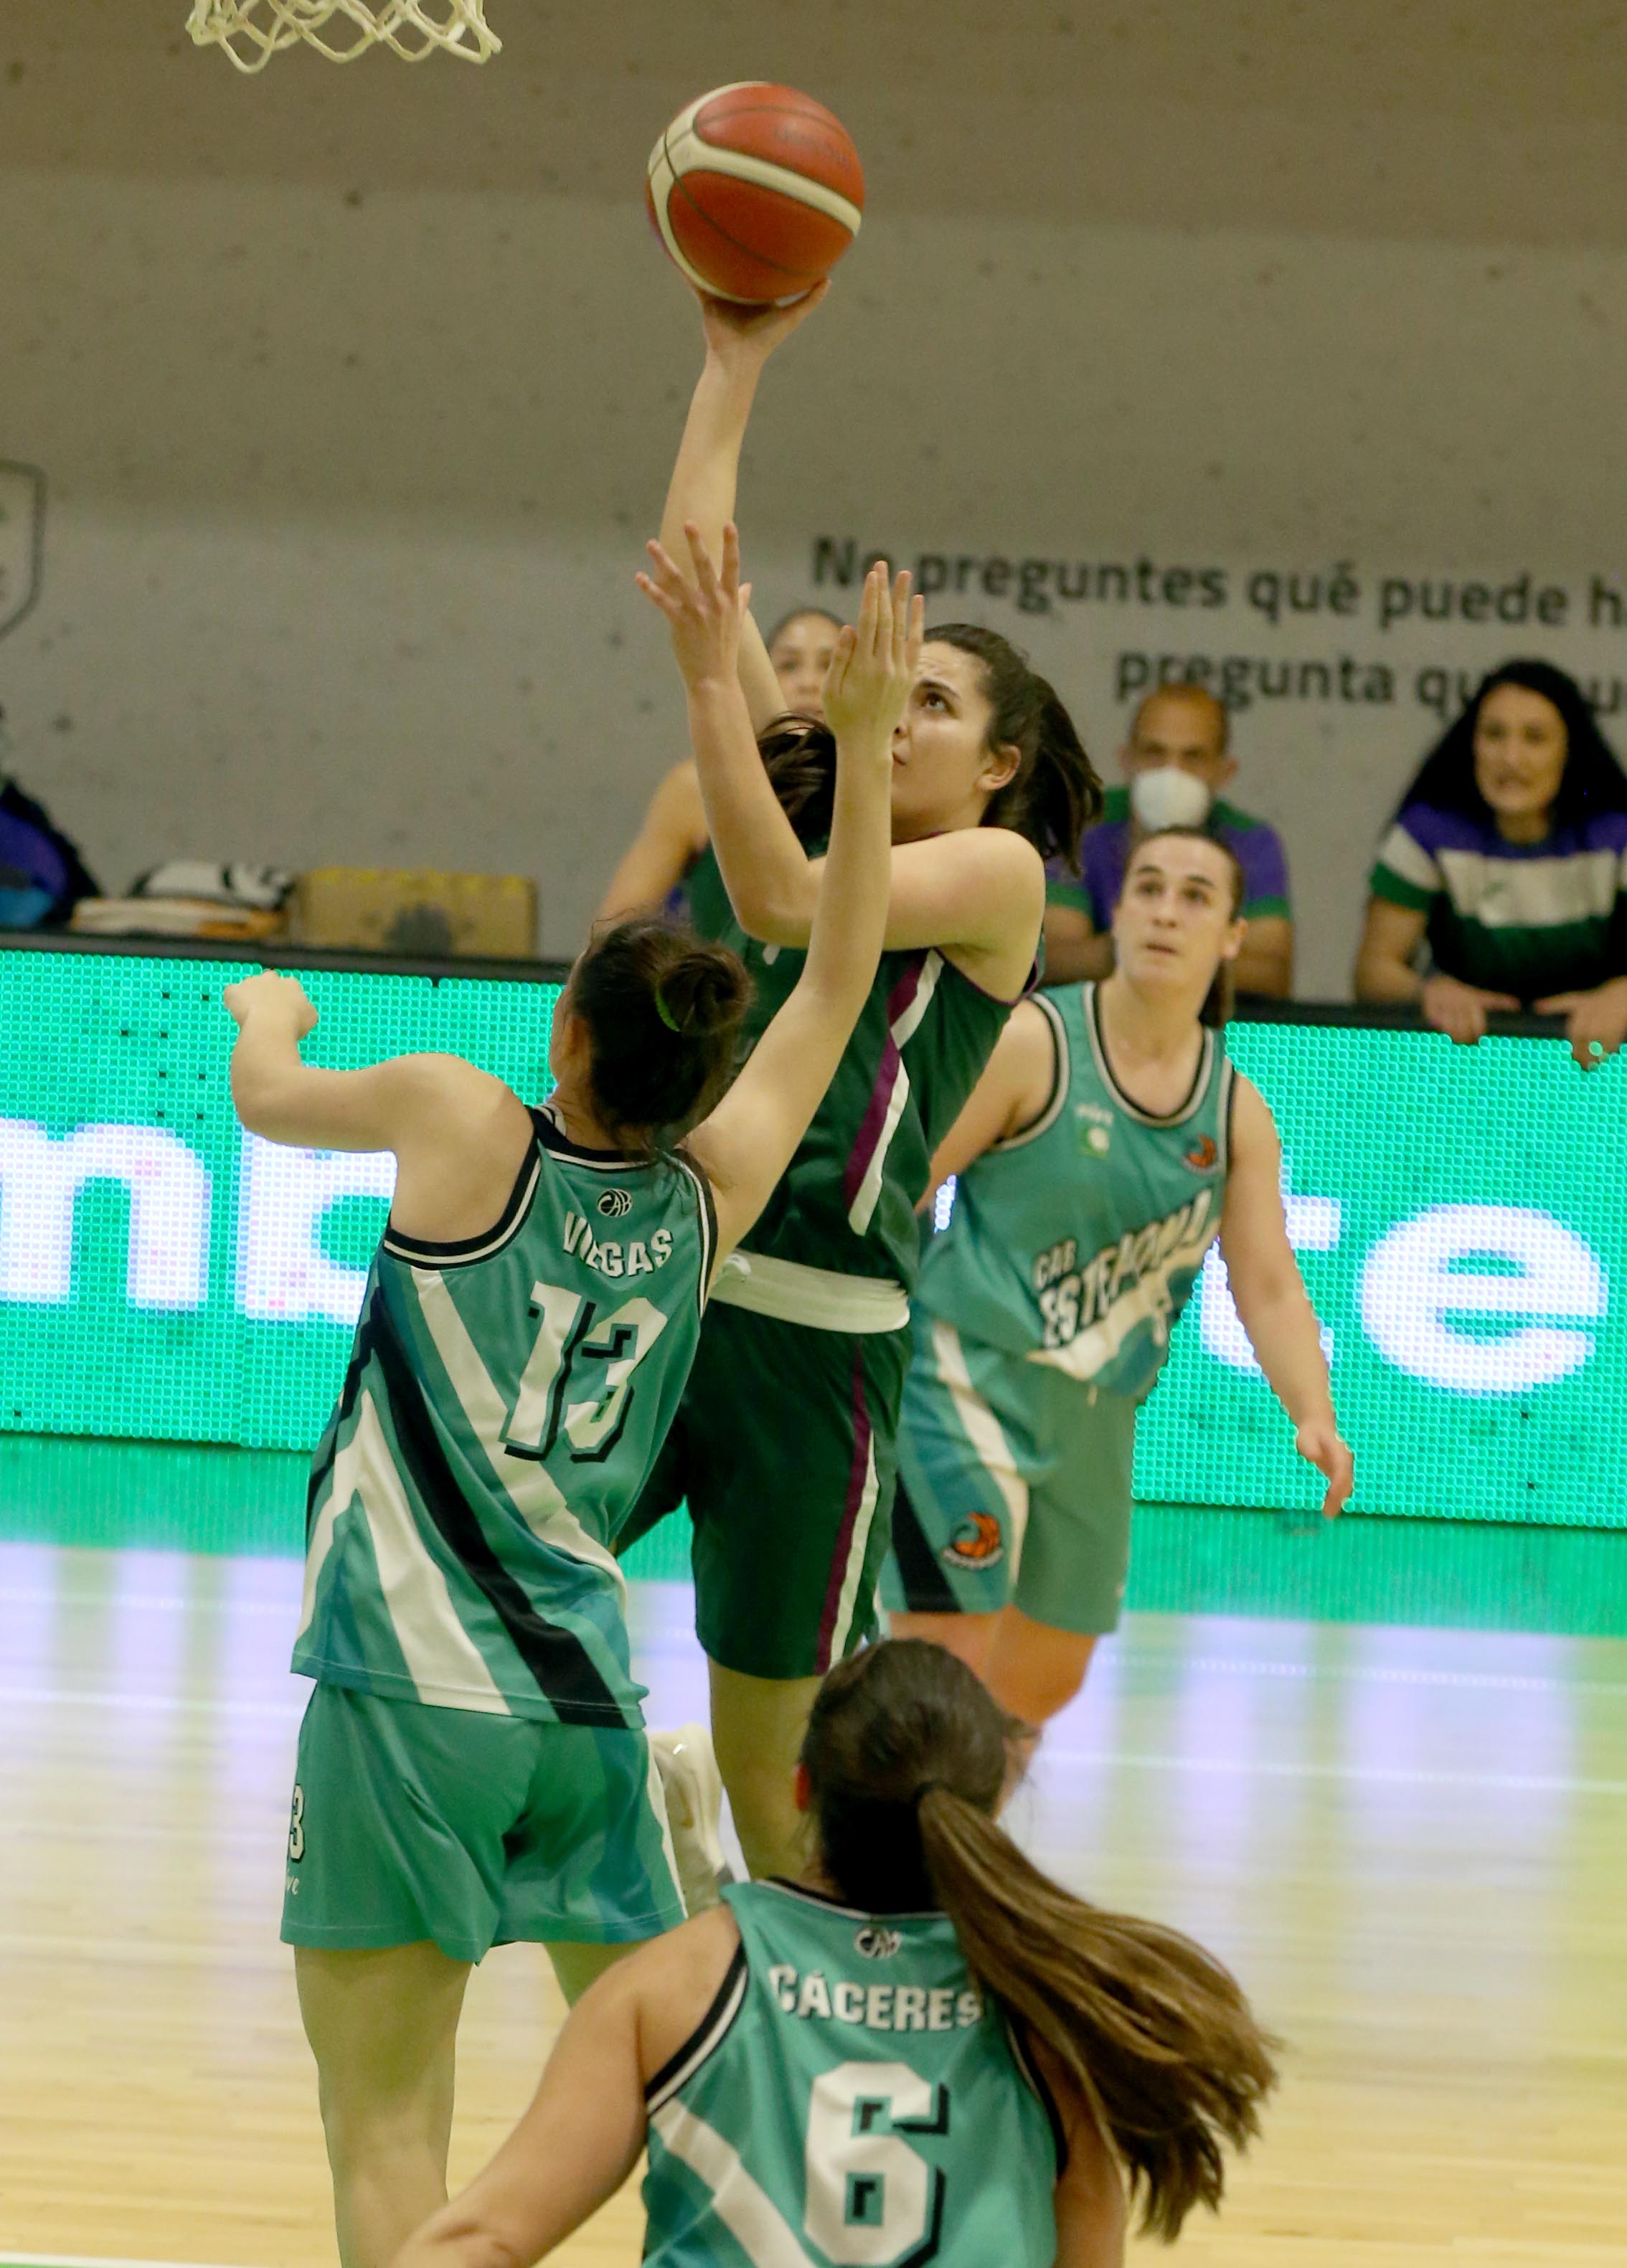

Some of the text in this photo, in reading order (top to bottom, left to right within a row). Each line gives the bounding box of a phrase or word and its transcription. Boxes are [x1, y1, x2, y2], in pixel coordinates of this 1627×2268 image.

[917, 551, 1228, 615] preguntes
[1248, 561, 1359, 624] qué
[1381, 571, 1569, 630] puede
[502, 1280, 669, 1461] 13
[768, 1964, 984, 2031] CÁCERES
[803, 2061, 950, 2267] 6
